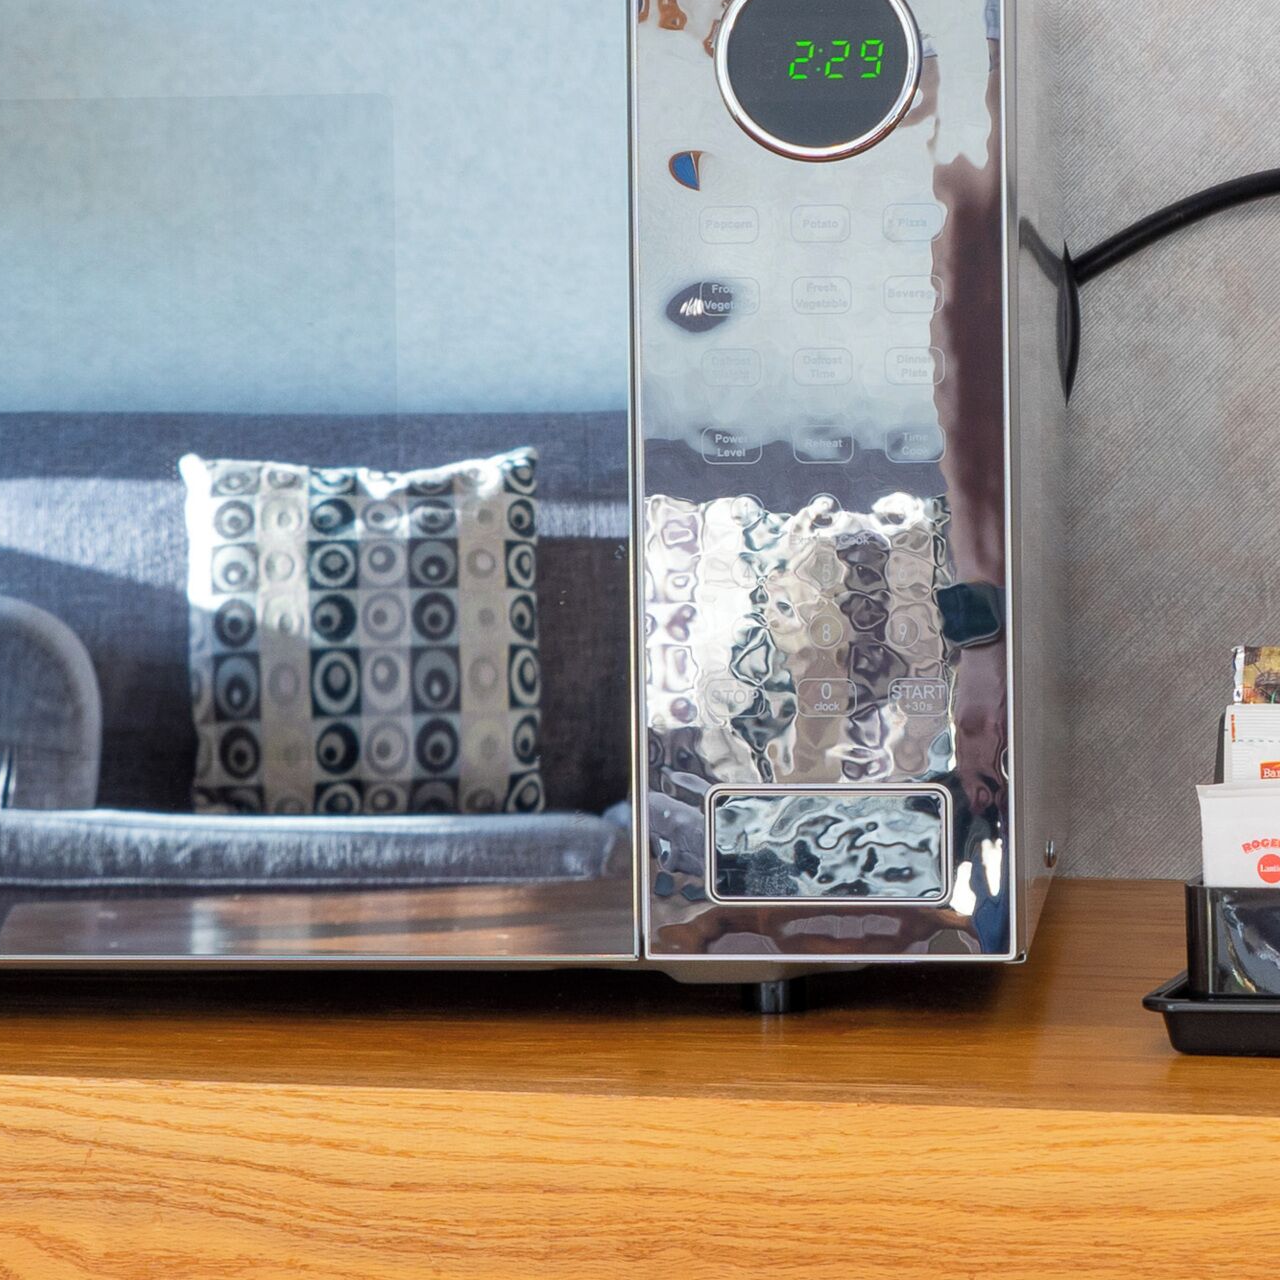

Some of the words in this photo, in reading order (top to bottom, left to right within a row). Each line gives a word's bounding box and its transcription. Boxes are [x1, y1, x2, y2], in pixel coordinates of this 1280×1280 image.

[788, 39, 885, 80] 2:29
[804, 438, 843, 449] Reheat
[717, 448, 746, 457] Level
[821, 623, 832, 642] 8
[898, 623, 908, 641] 9
[711, 688, 759, 704] STOP
[891, 685, 946, 701] START
[814, 701, 840, 712] clock
[904, 702, 933, 712] +30s
